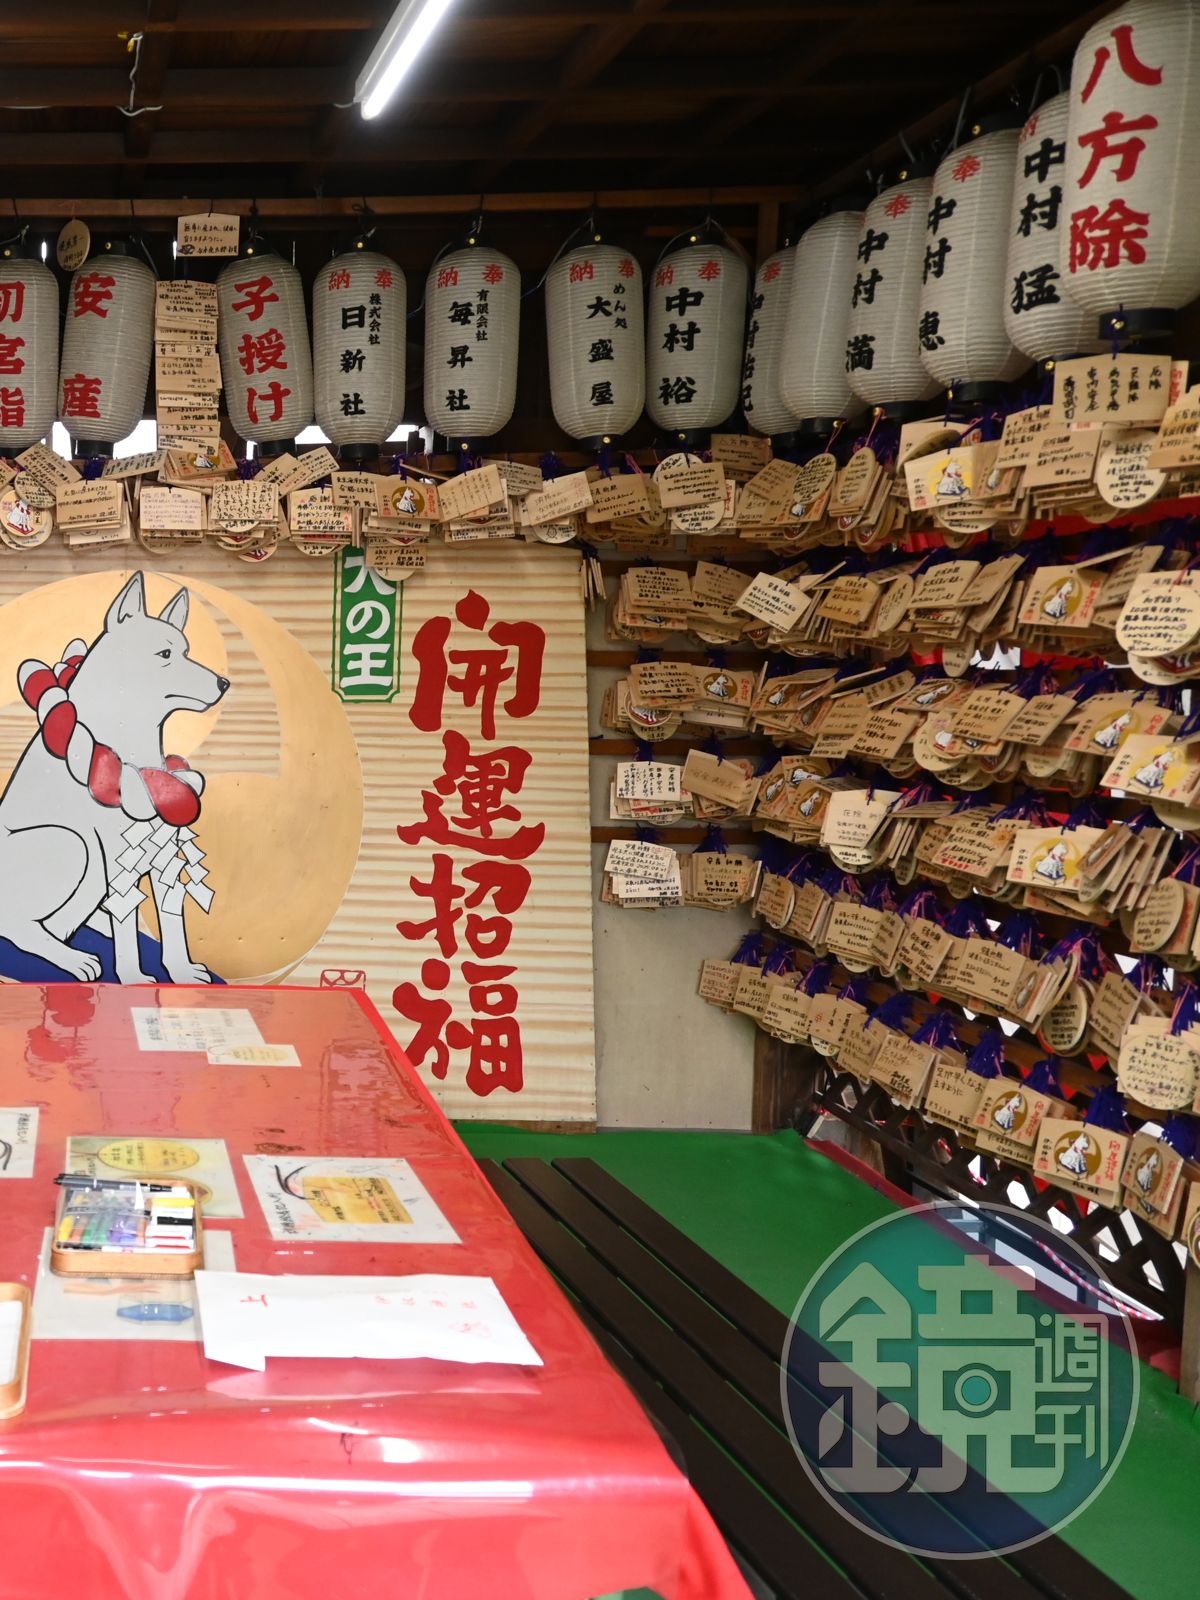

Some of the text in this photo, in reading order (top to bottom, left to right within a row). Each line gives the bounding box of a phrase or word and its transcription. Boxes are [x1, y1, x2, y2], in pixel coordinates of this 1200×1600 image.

[952, 155, 980, 183] 奉
[1069, 24, 1163, 274] 八方除
[884, 193, 910, 219] 奉
[1011, 137, 1066, 314] 中村猛
[328, 269, 394, 290] 奉 納
[368, 293, 381, 345] 株式会社
[437, 264, 503, 289] 奉 納
[475, 288, 490, 342] 有限会社
[569, 259, 635, 284] 奉 納
[612, 283, 629, 330] めん処
[698, 260, 720, 282] 奉
[846, 229, 888, 373] 中村満
[61, 272, 117, 420] 安産
[232, 276, 292, 425] 子授け
[340, 304, 367, 416] 日新社
[445, 301, 476, 412] 毎昇社
[587, 296, 615, 406] 大盛屋
[658, 287, 704, 406] 中村裕
[392, 590, 547, 1097] 開運招福
